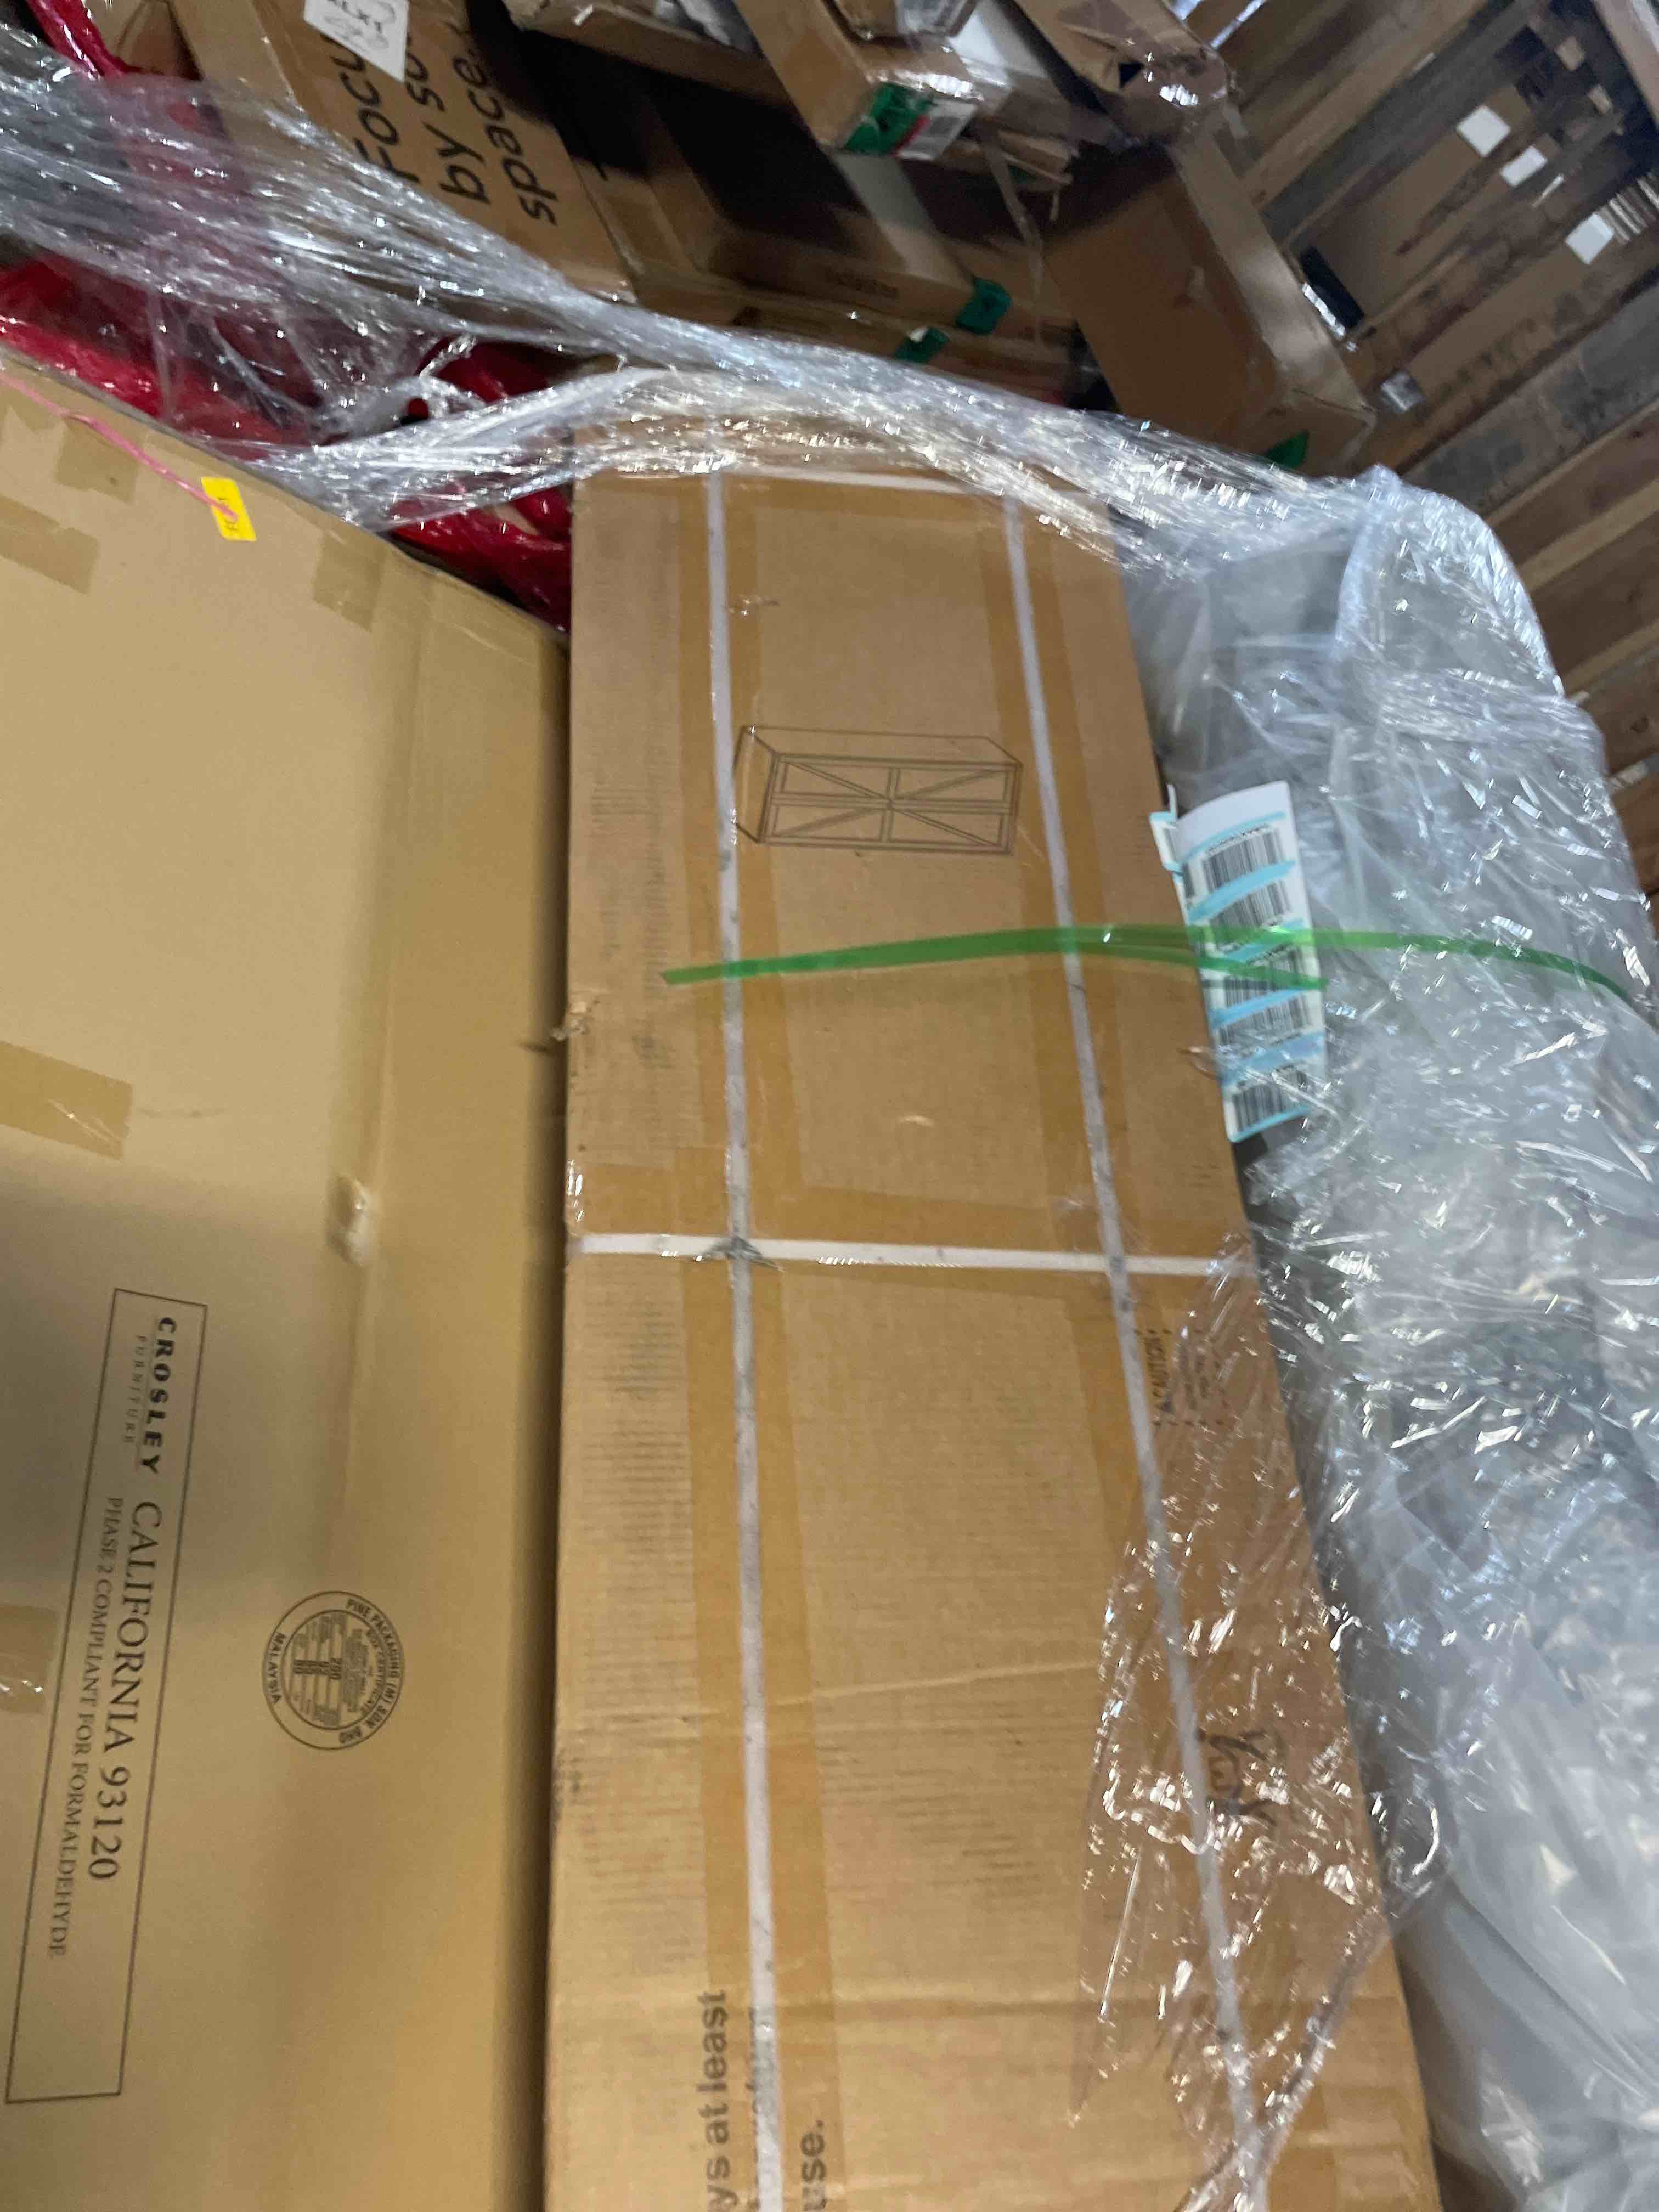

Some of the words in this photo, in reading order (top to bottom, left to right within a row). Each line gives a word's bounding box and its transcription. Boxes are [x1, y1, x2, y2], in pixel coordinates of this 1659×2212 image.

[422, 121, 492, 206] by
[123, 1335, 148, 1444] FURNITURE
[141, 1317, 177, 1475] CROSLEY
[96, 1564, 113, 1574] 2
[101, 1497, 123, 1559] PHASE
[81, 1579, 114, 1708] COMPLIANT
[103, 1500, 163, 1752] CALIFORNIA
[267, 1632, 287, 1705] MALAYSIA
[71, 1713, 94, 1756] FOR
[47, 1762, 89, 1960] FORMALDEHYDE
[89, 1765, 131, 1881] 93120
[696, 1990, 729, 2093] least
[698, 2101, 729, 2145] at
